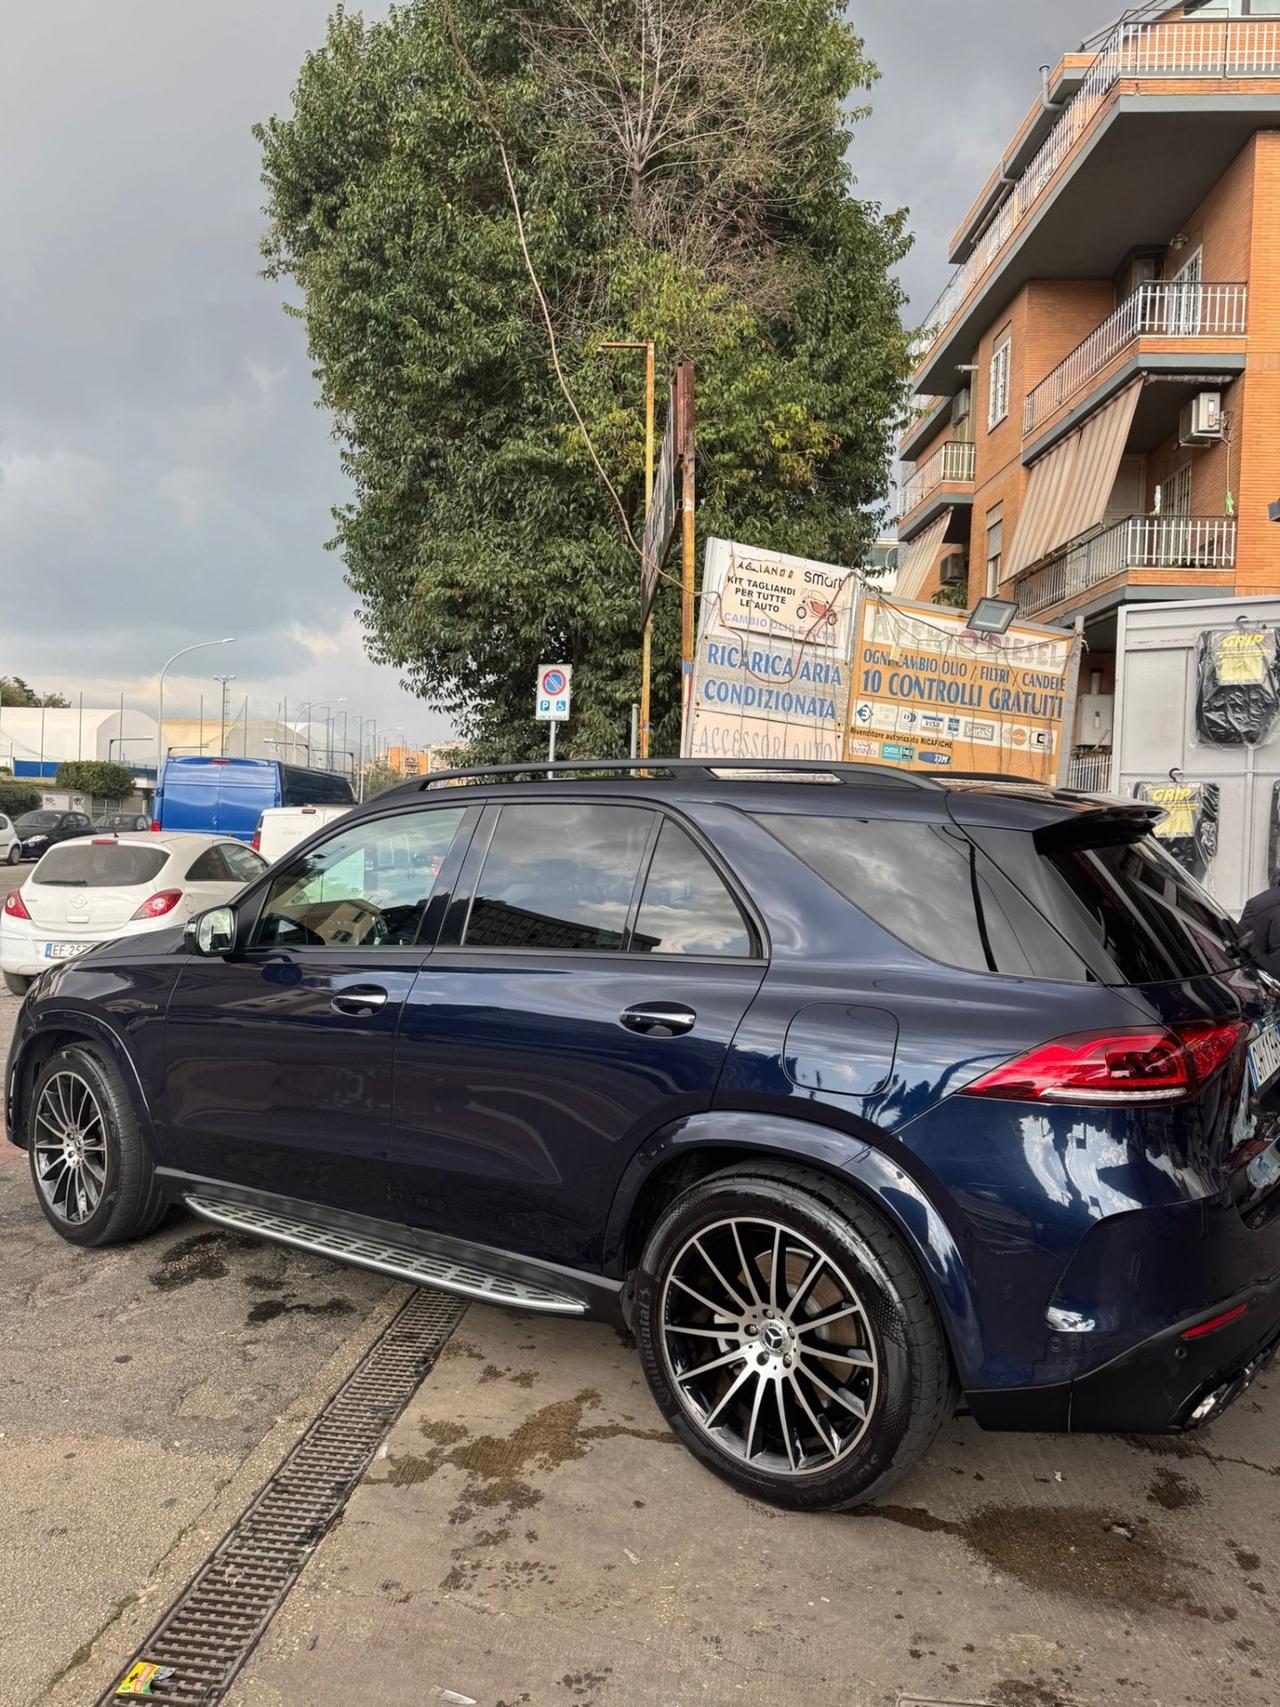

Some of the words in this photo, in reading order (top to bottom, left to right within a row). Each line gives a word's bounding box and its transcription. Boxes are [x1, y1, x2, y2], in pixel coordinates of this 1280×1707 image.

[727, 575, 744, 586] KIT
[747, 579, 796, 597] TAGLIANDI
[803, 570, 843, 591] smart
[735, 587, 754, 599] PER
[755, 591, 787, 605] TUTTE
[739, 598, 752, 608] LE
[754, 601, 780, 614] AUTO
[724, 612, 768, 628] CAMBIO
[1222, 634, 1265, 648] GRIP
[707, 642, 794, 679] RICARICA
[799, 660, 842, 686] ARIA
[896, 653, 938, 673] AMBIO
[942, 660, 967, 677] OLIO
[980, 665, 1010, 684] FILTRI
[703, 678, 837, 720] CONDIZIONATA
[863, 668, 882, 693] 10
[888, 671, 983, 708] CONTROLLI
[988, 686, 1064, 719] GRATUITI
[849, 727, 884, 739] Rivenditore
[885, 734, 920, 744] autorizzato
[933, 754, 948, 763] TIM
[1152, 788, 1194, 802] GRIP
